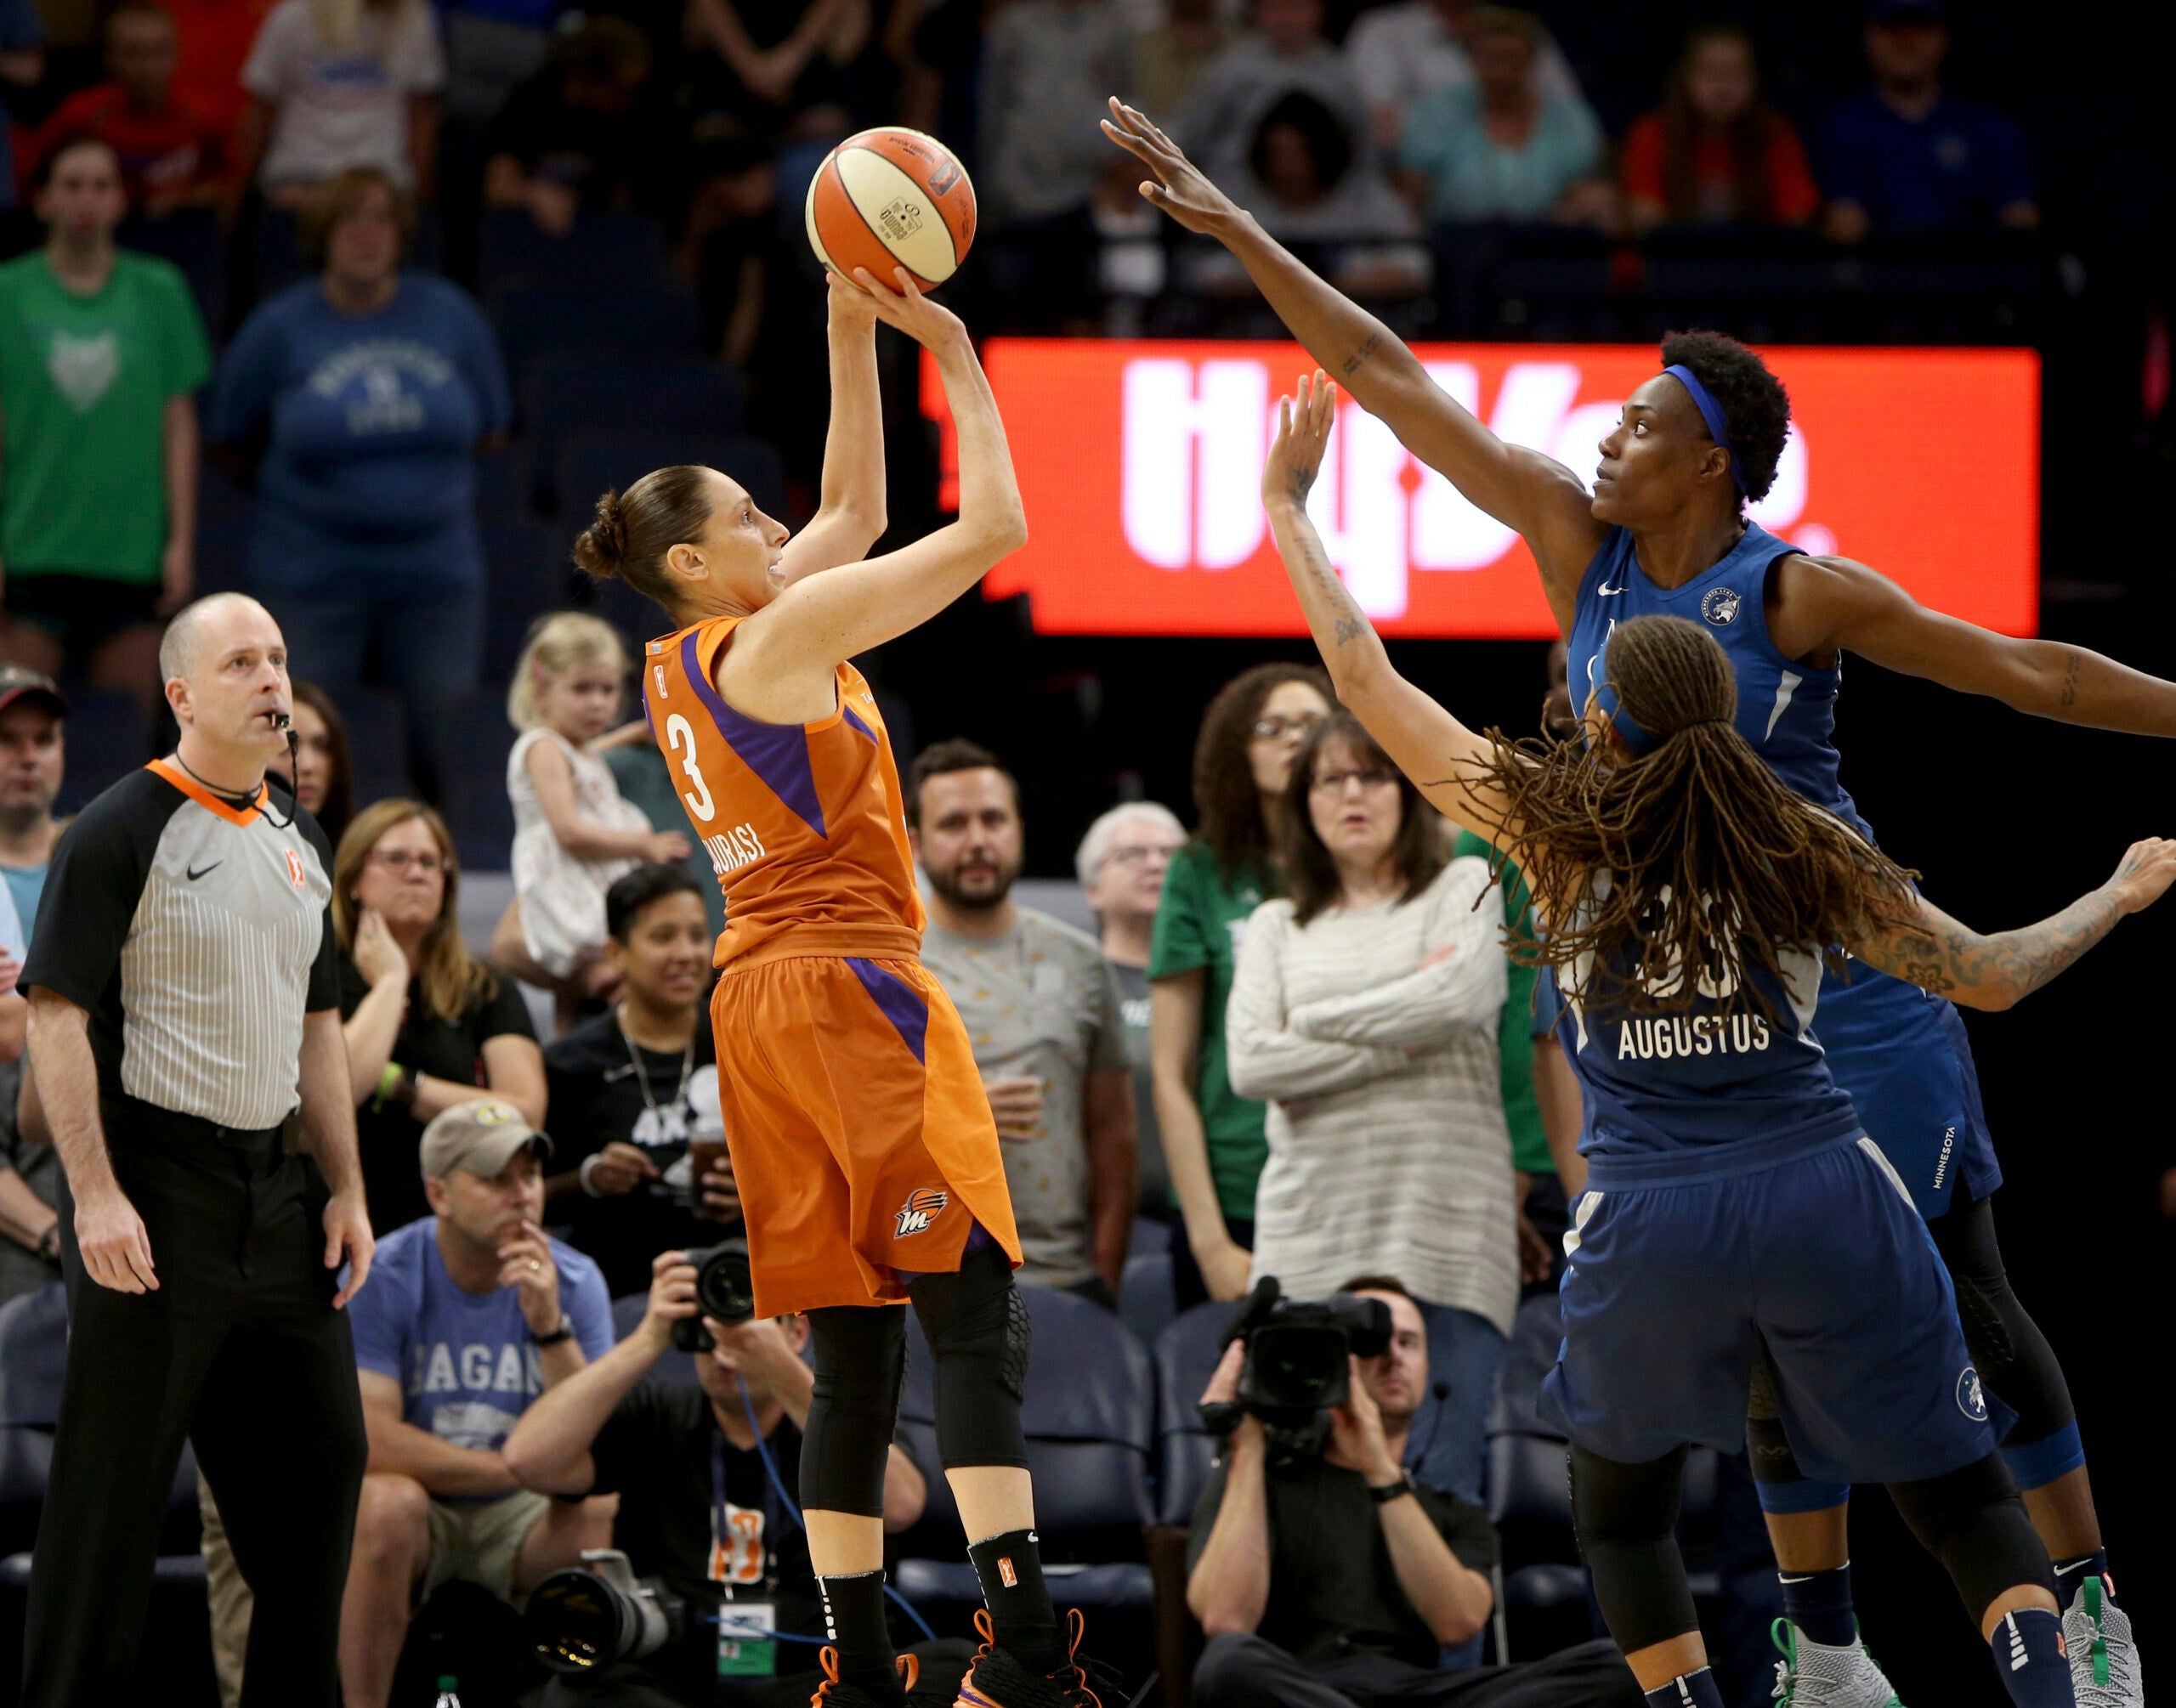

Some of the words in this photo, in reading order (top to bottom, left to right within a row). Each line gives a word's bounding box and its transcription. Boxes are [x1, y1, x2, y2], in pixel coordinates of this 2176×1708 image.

[1121, 357, 1810, 620] HyV
[666, 713, 716, 822] 3
[1618, 1014, 1771, 1060] AUGUSTUS
[1932, 1127, 1955, 1189] MINNESOTA
